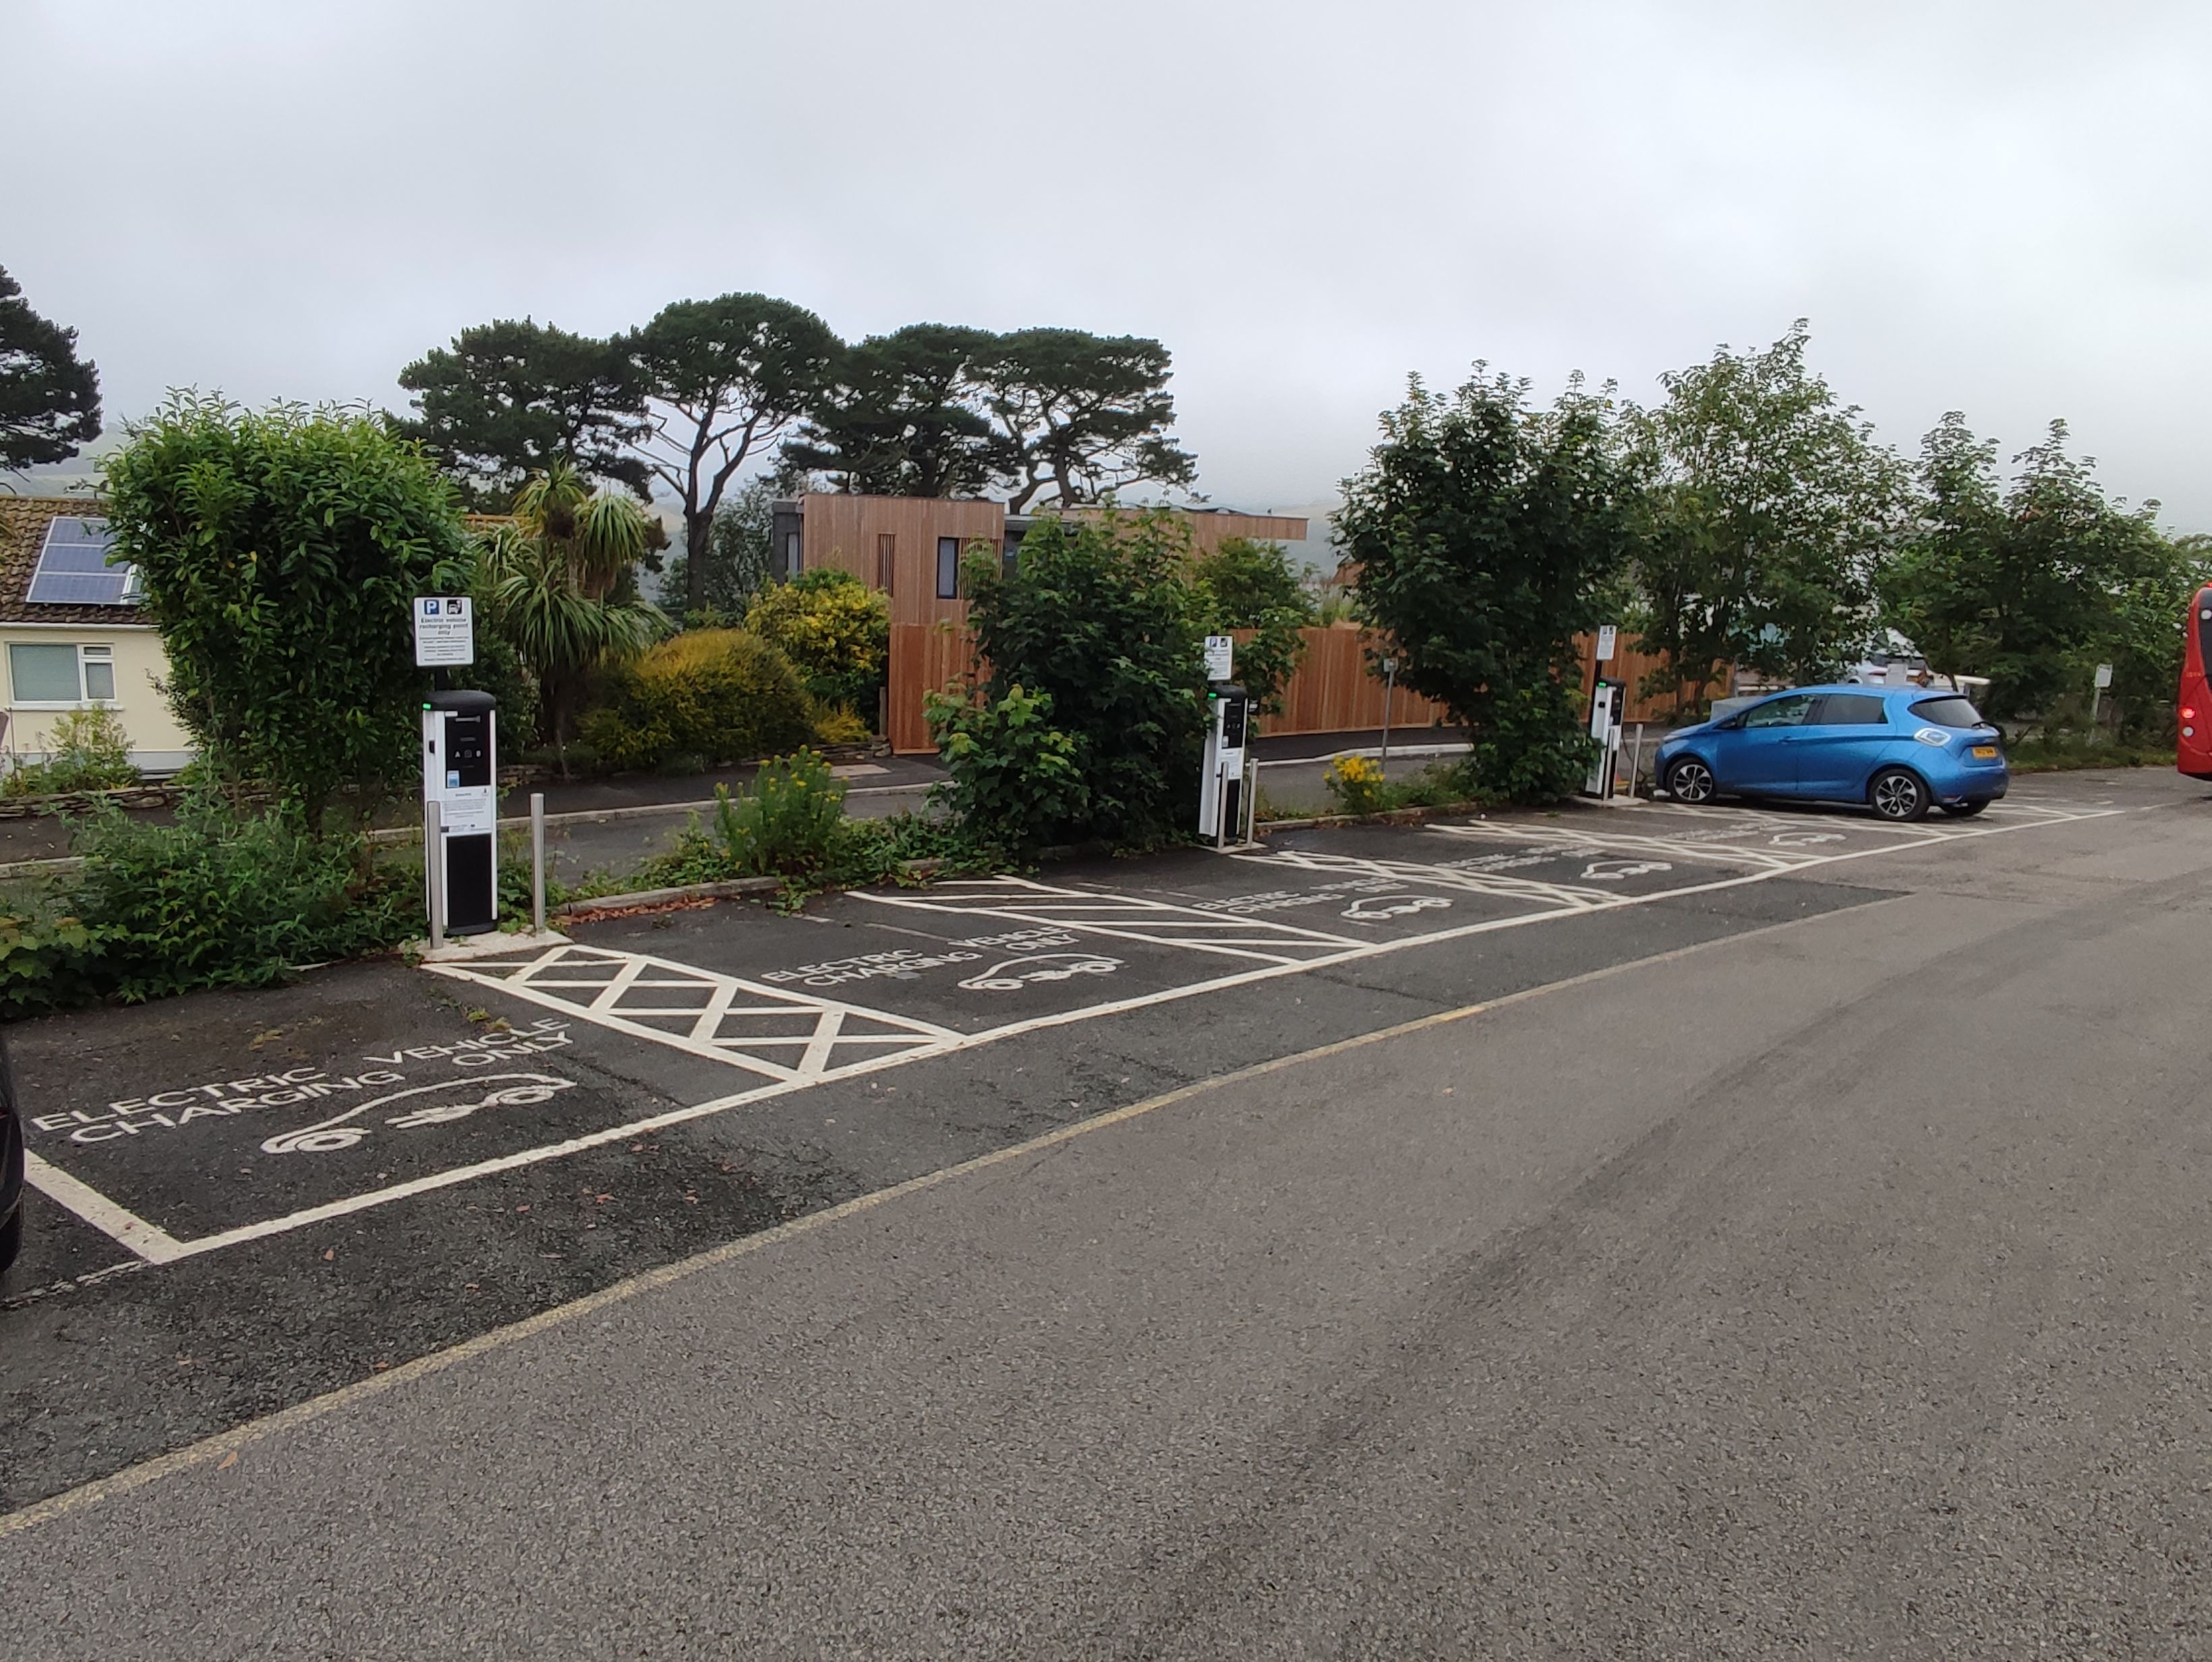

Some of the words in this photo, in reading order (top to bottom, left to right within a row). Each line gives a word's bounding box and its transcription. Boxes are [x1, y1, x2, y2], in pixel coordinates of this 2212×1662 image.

[426, 600, 437, 614] P
[761, 948, 923, 981] ELECTRIC
[948, 926, 1072, 948] VEHICLE
[804, 950, 983, 986] CHARGING
[31, 1066, 327, 1131] ELECTRIC
[362, 1017, 571, 1064] VEHICLE
[70, 1070, 406, 1142] CHARGING
[452, 1030, 573, 1066] ONLY
